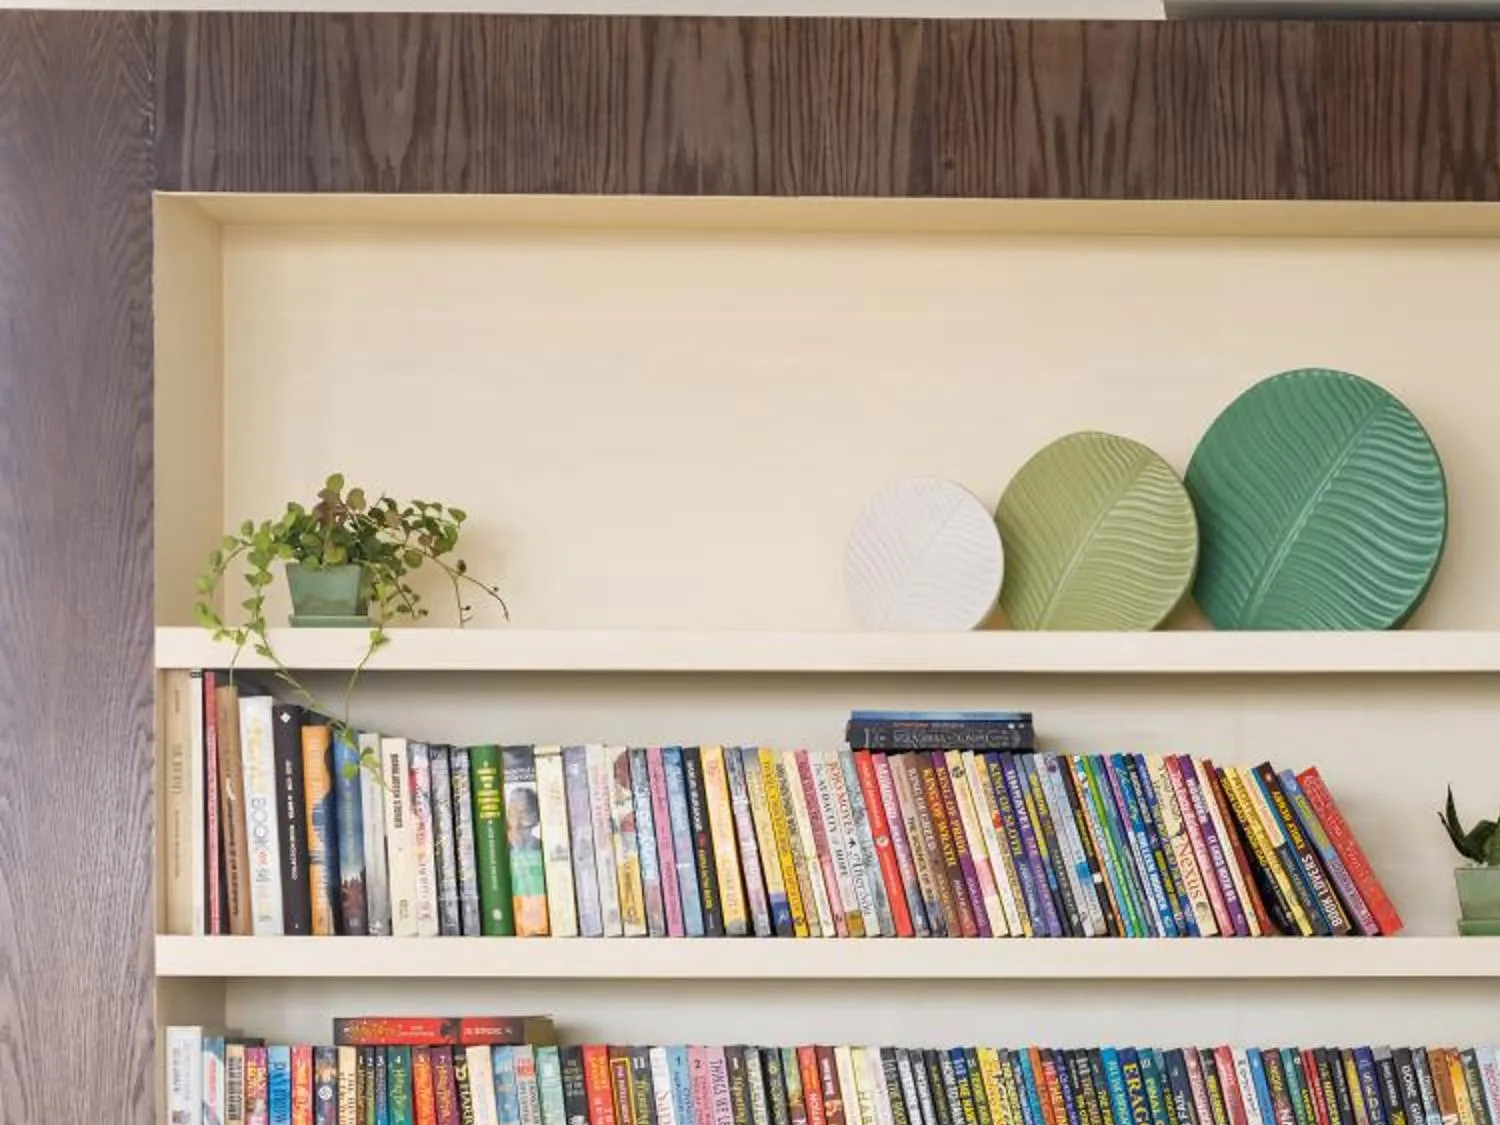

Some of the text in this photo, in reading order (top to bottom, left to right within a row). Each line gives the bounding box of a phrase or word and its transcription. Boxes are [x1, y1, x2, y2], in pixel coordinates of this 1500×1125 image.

[1301, 853, 1326, 896] LOVERS
[1320, 898, 1342, 928] BOOK
[711, 1060, 726, 1094] THINGS
[959, 1078, 970, 1099] THE
[1049, 1078, 1063, 1105] THE
[717, 1097, 728, 1112] WE
[943, 1060, 955, 1085] HOW
[949, 1101, 963, 1125] TALK
[1146, 1077, 1160, 1114] FINAL
[1175, 1090, 1189, 1119] FAIL
